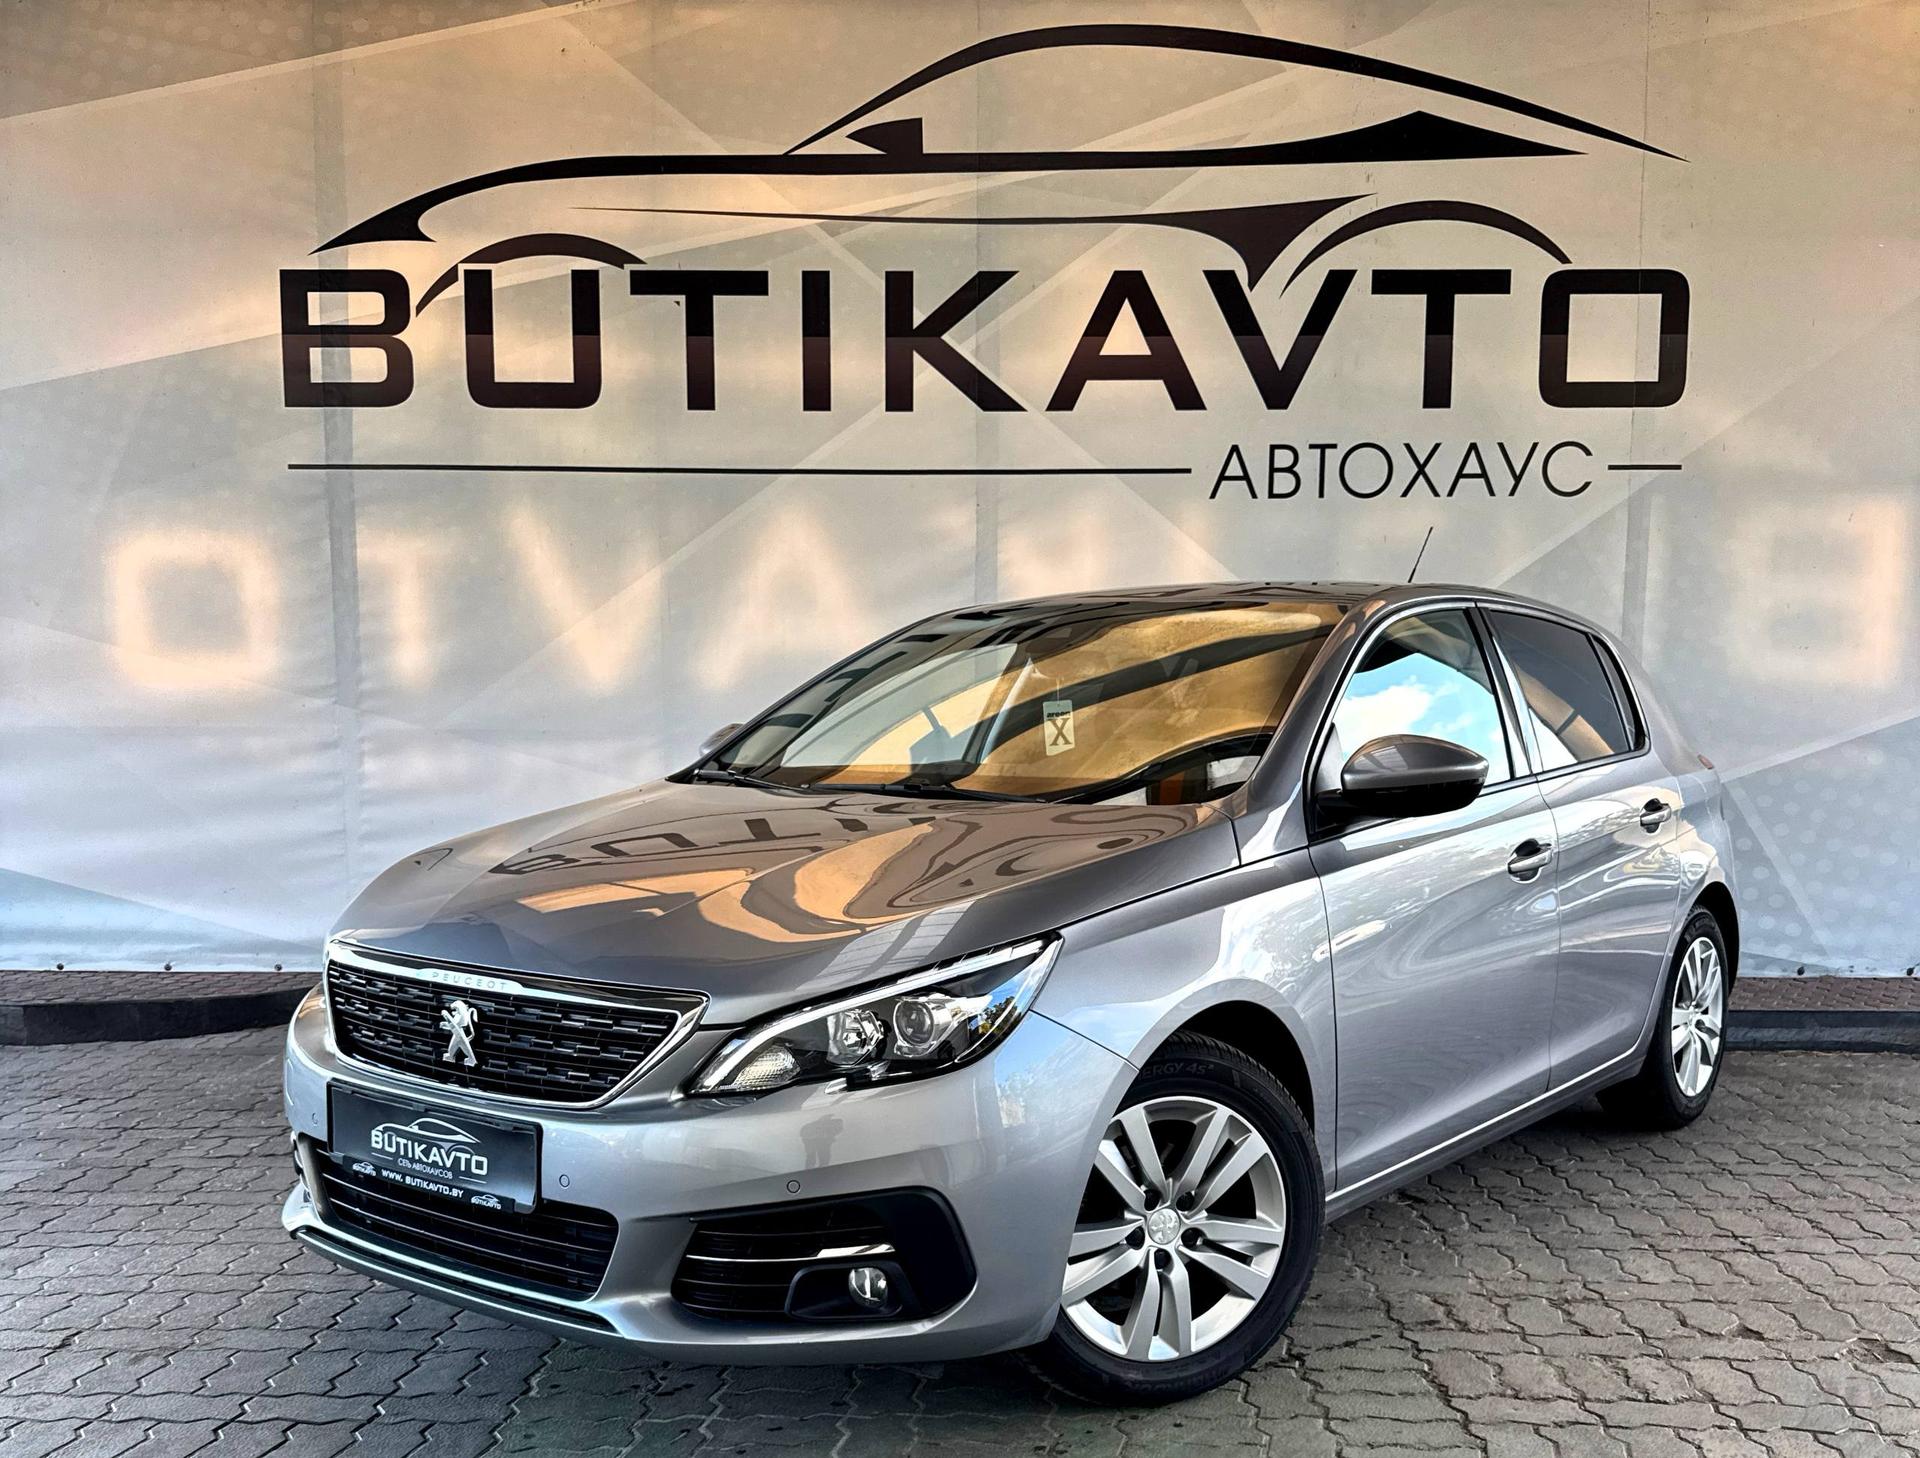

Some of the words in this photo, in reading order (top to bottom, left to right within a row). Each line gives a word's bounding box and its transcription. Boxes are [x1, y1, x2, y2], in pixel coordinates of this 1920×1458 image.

[280, 268, 1690, 412] BUTIKAVTO
[1208, 440, 1594, 500] АВТОХАУС
[1047, 717, 1073, 747] X
[431, 971, 508, 990] PEUGEOT
[1138, 1062, 1185, 1080] ERGY
[371, 1130, 488, 1176] BUTIKAVTO
